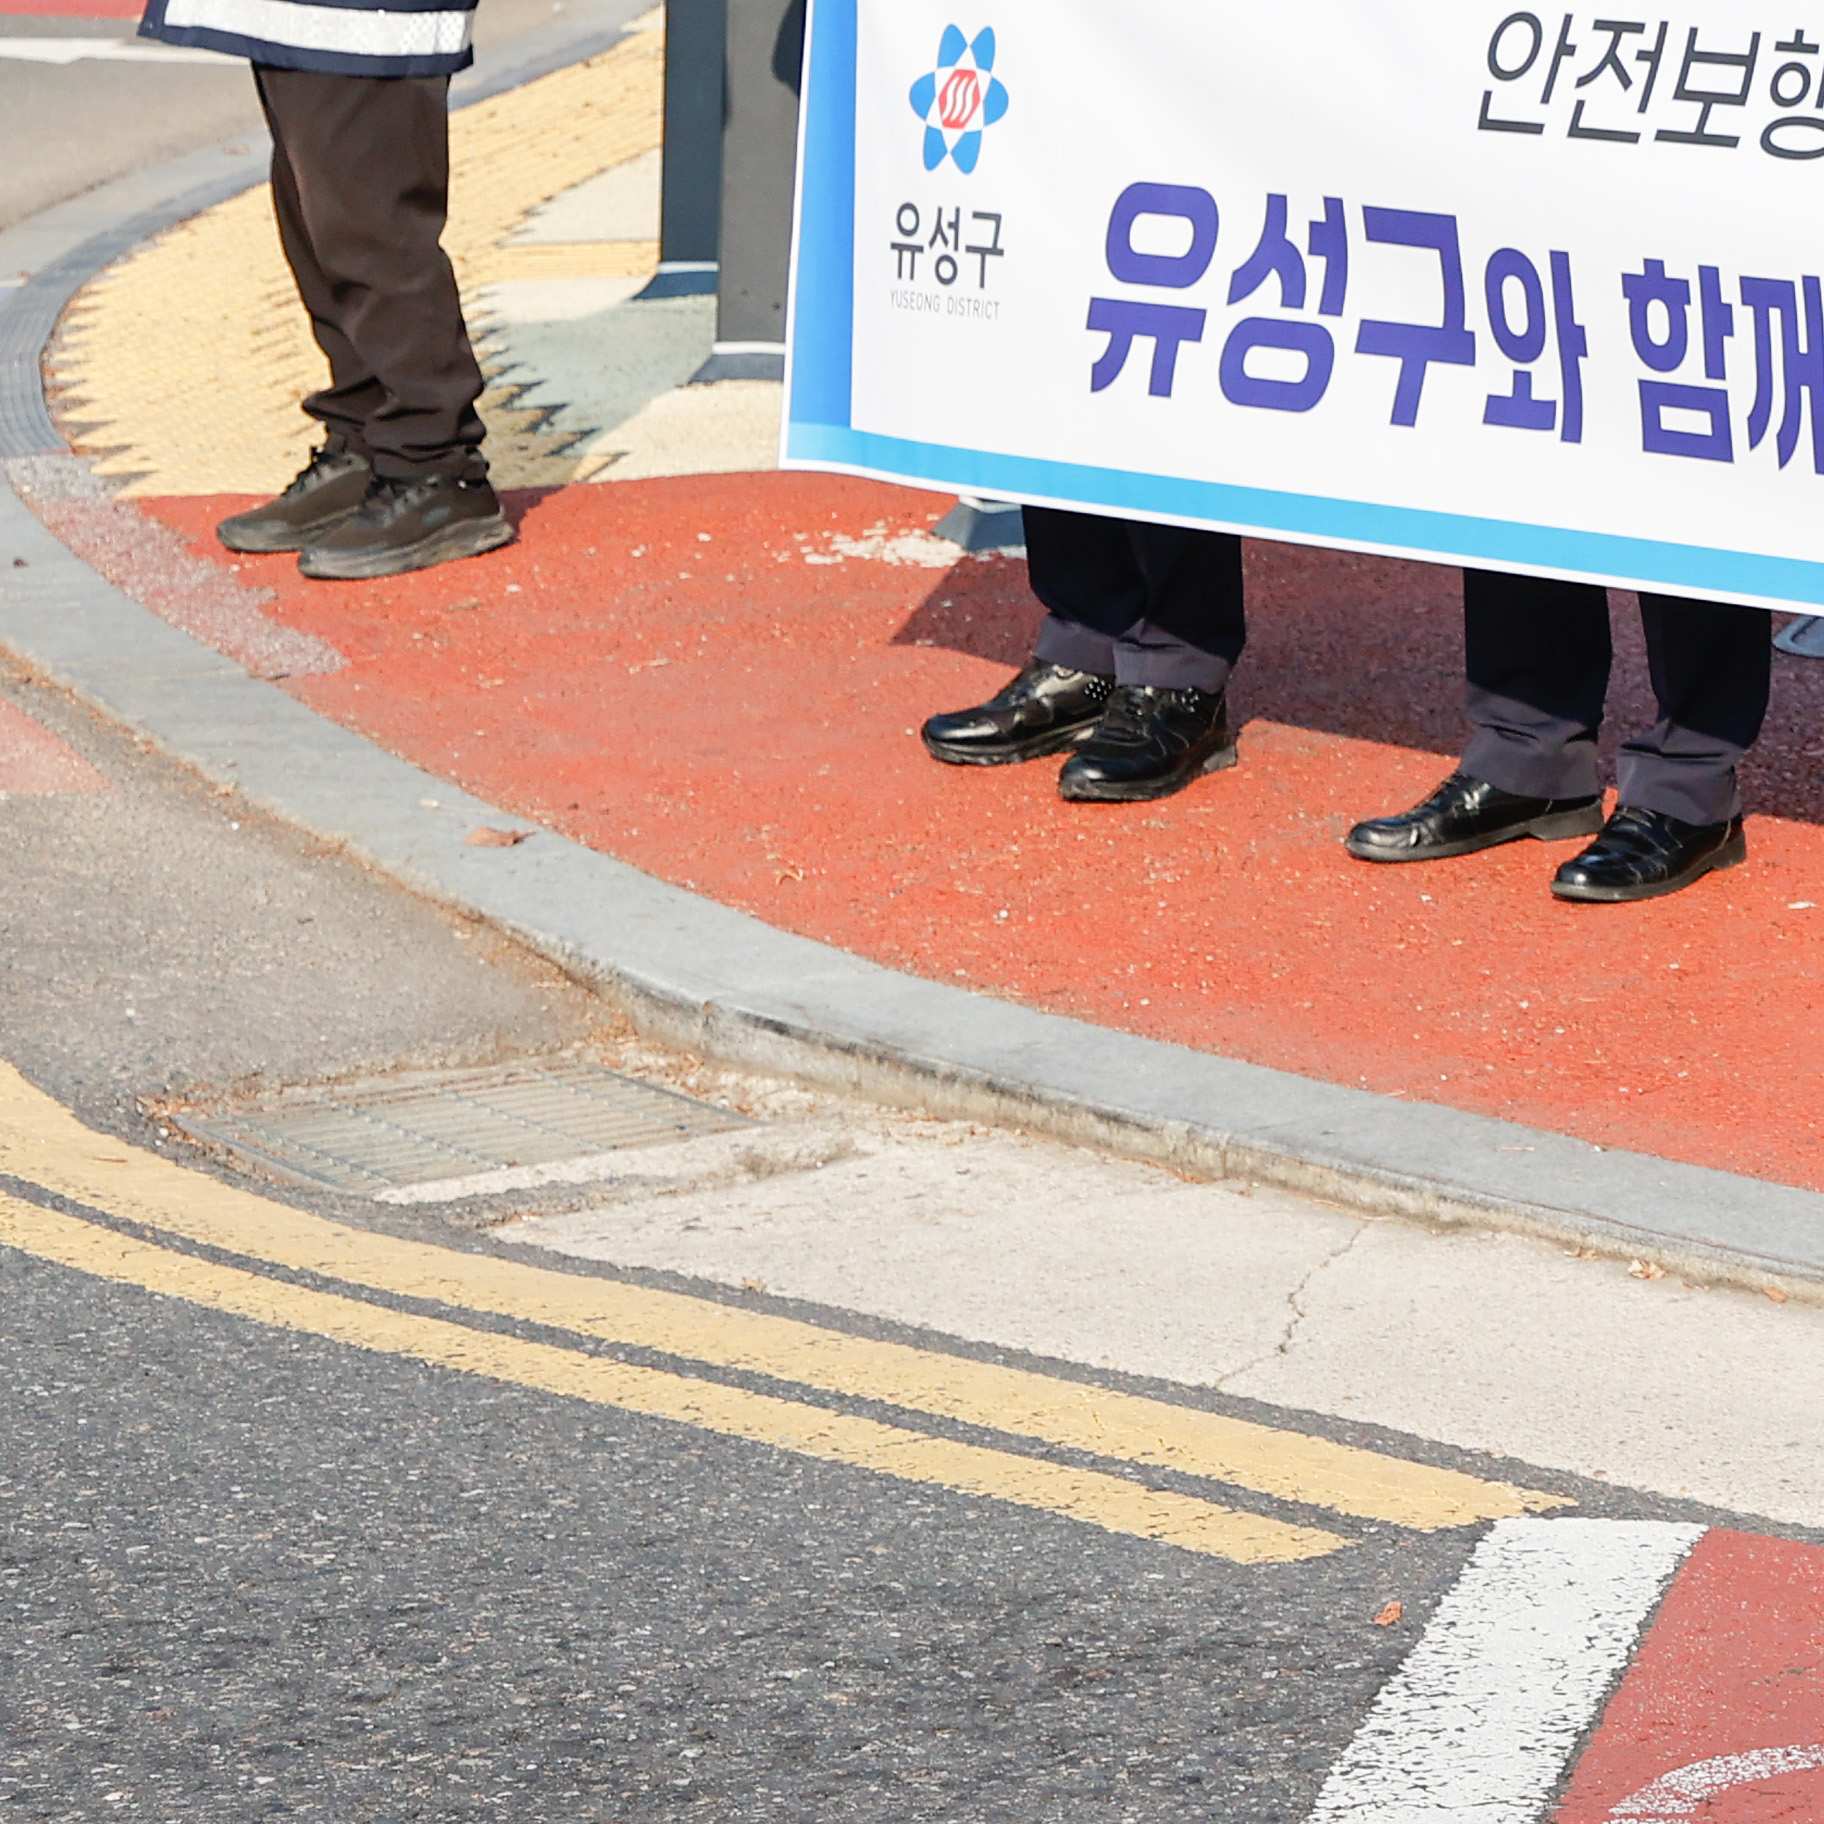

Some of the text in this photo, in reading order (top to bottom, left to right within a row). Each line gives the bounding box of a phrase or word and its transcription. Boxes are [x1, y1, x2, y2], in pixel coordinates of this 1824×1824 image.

[891, 204, 1003, 287] 유성구
[889, 289, 1000, 320] YUSEONG DISTRICT
[1087, 182, 1587, 443] 유성구와
